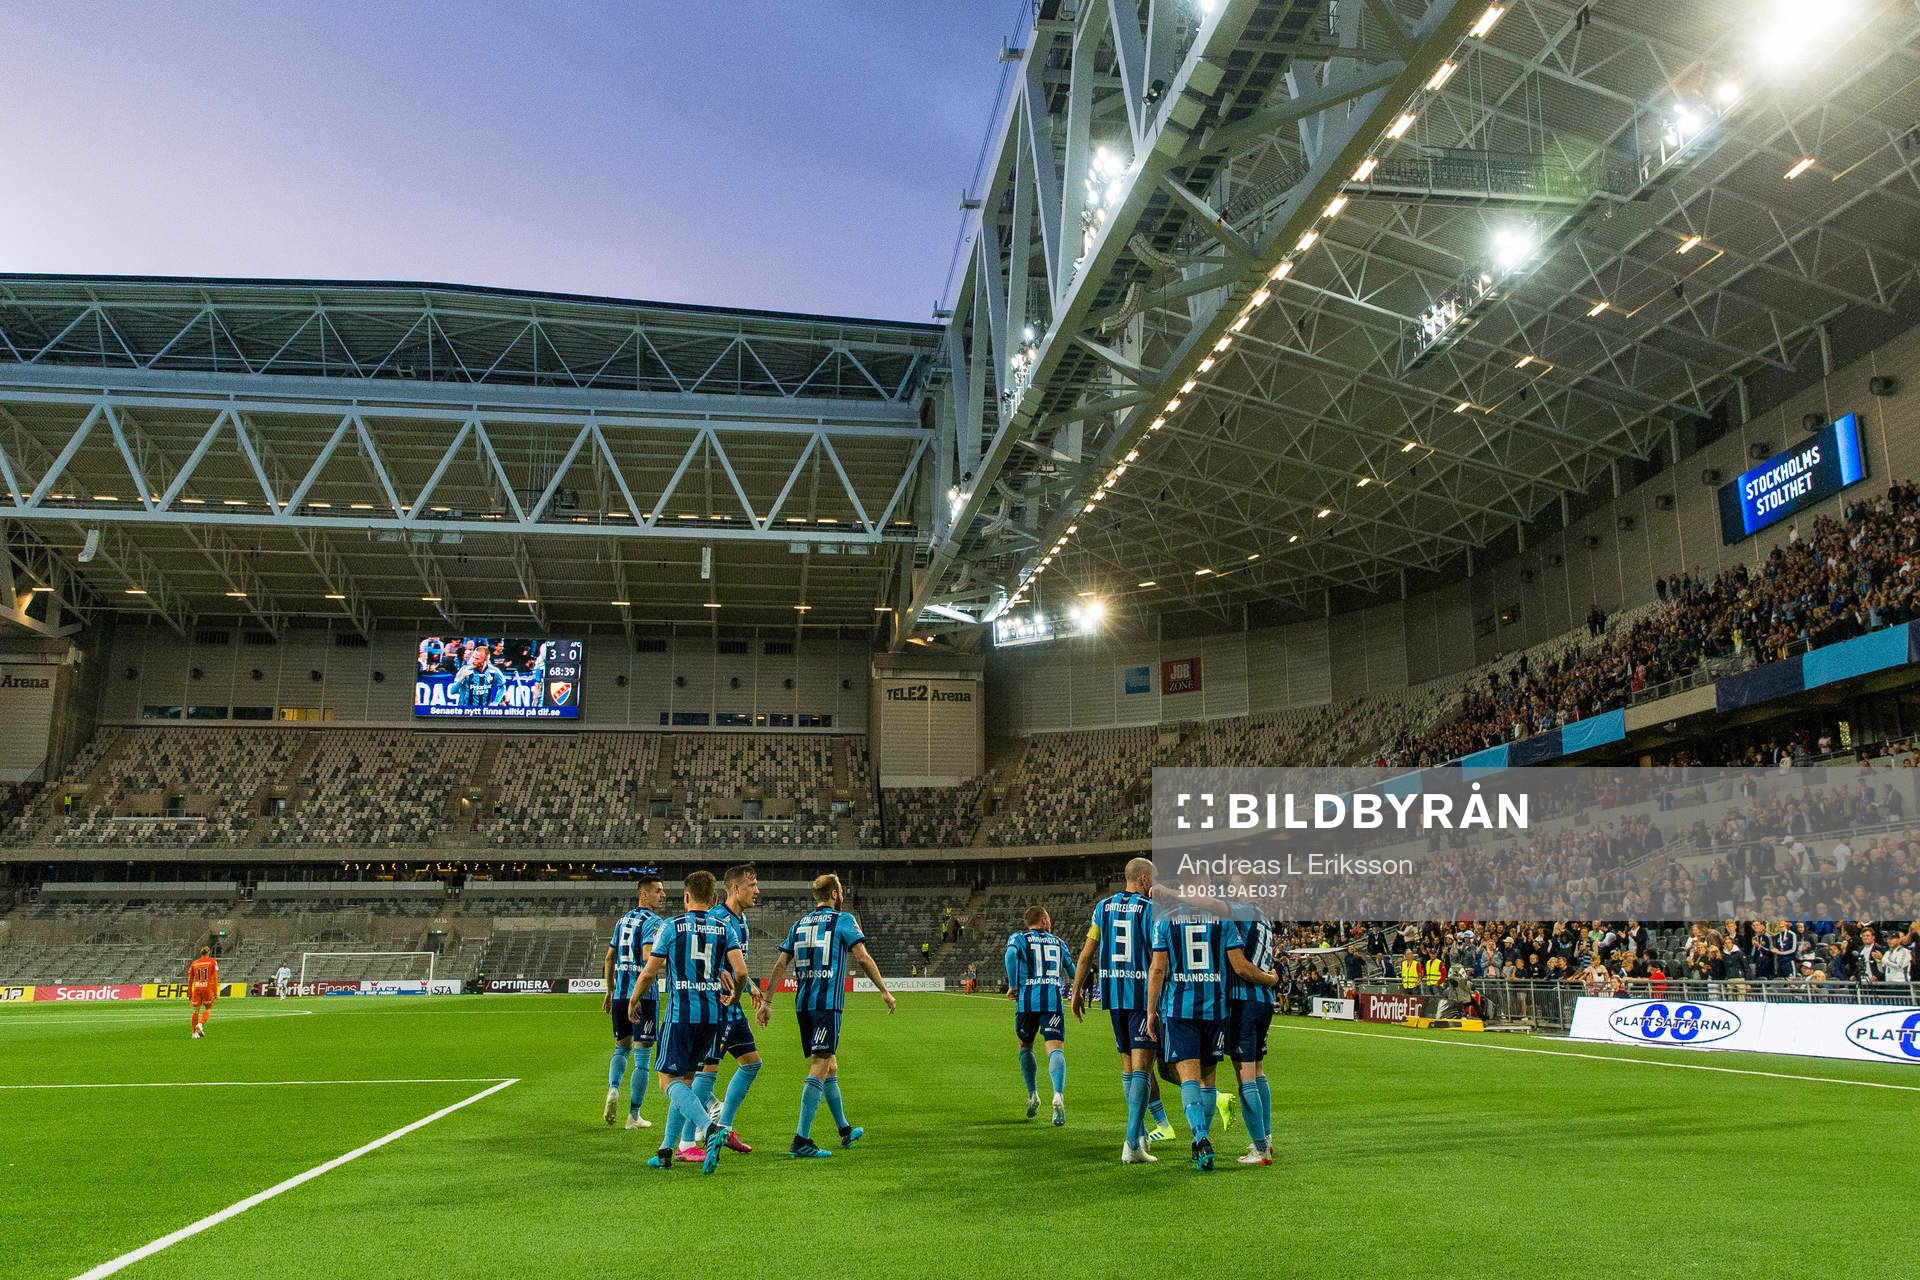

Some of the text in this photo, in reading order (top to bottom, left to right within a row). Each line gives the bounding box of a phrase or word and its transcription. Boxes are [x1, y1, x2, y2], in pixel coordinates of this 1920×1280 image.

[1746, 446, 1821, 500] STOCKHOLMS
[1756, 472, 1813, 516] STOLTHET
[549, 649, 557, 660] 3
[569, 649, 577, 661] 0
[549, 667, 576, 676] 68:39
[1170, 663, 1190, 680] JOB
[0, 675, 50, 689] Arena
[1169, 680, 1194, 692] ZONE
[886, 685, 972, 702] TELE2 Arena
[430, 707, 560, 717] Senaste nytt finns alltid på dif.se
[677, 923, 692, 933] UNE
[618, 926, 634, 962] 9
[794, 925, 832, 968] 24
[1112, 919, 1132, 962] 3
[1185, 925, 1210, 970] 6
[690, 934, 713, 980] 4
[1030, 943, 1061, 977] 19
[196, 968, 208, 981] 11
[1099, 968, 1147, 980] ERLANDSSON
[491, 980, 550, 990] OPTIMERA
[857, 980, 941, 989] NORCWELLNESS
[56, 986, 121, 1001] Scandic
[1370, 995, 1408, 1020] Prioritet
[1615, 1016, 1731, 1031] PLATTSATTARNA
